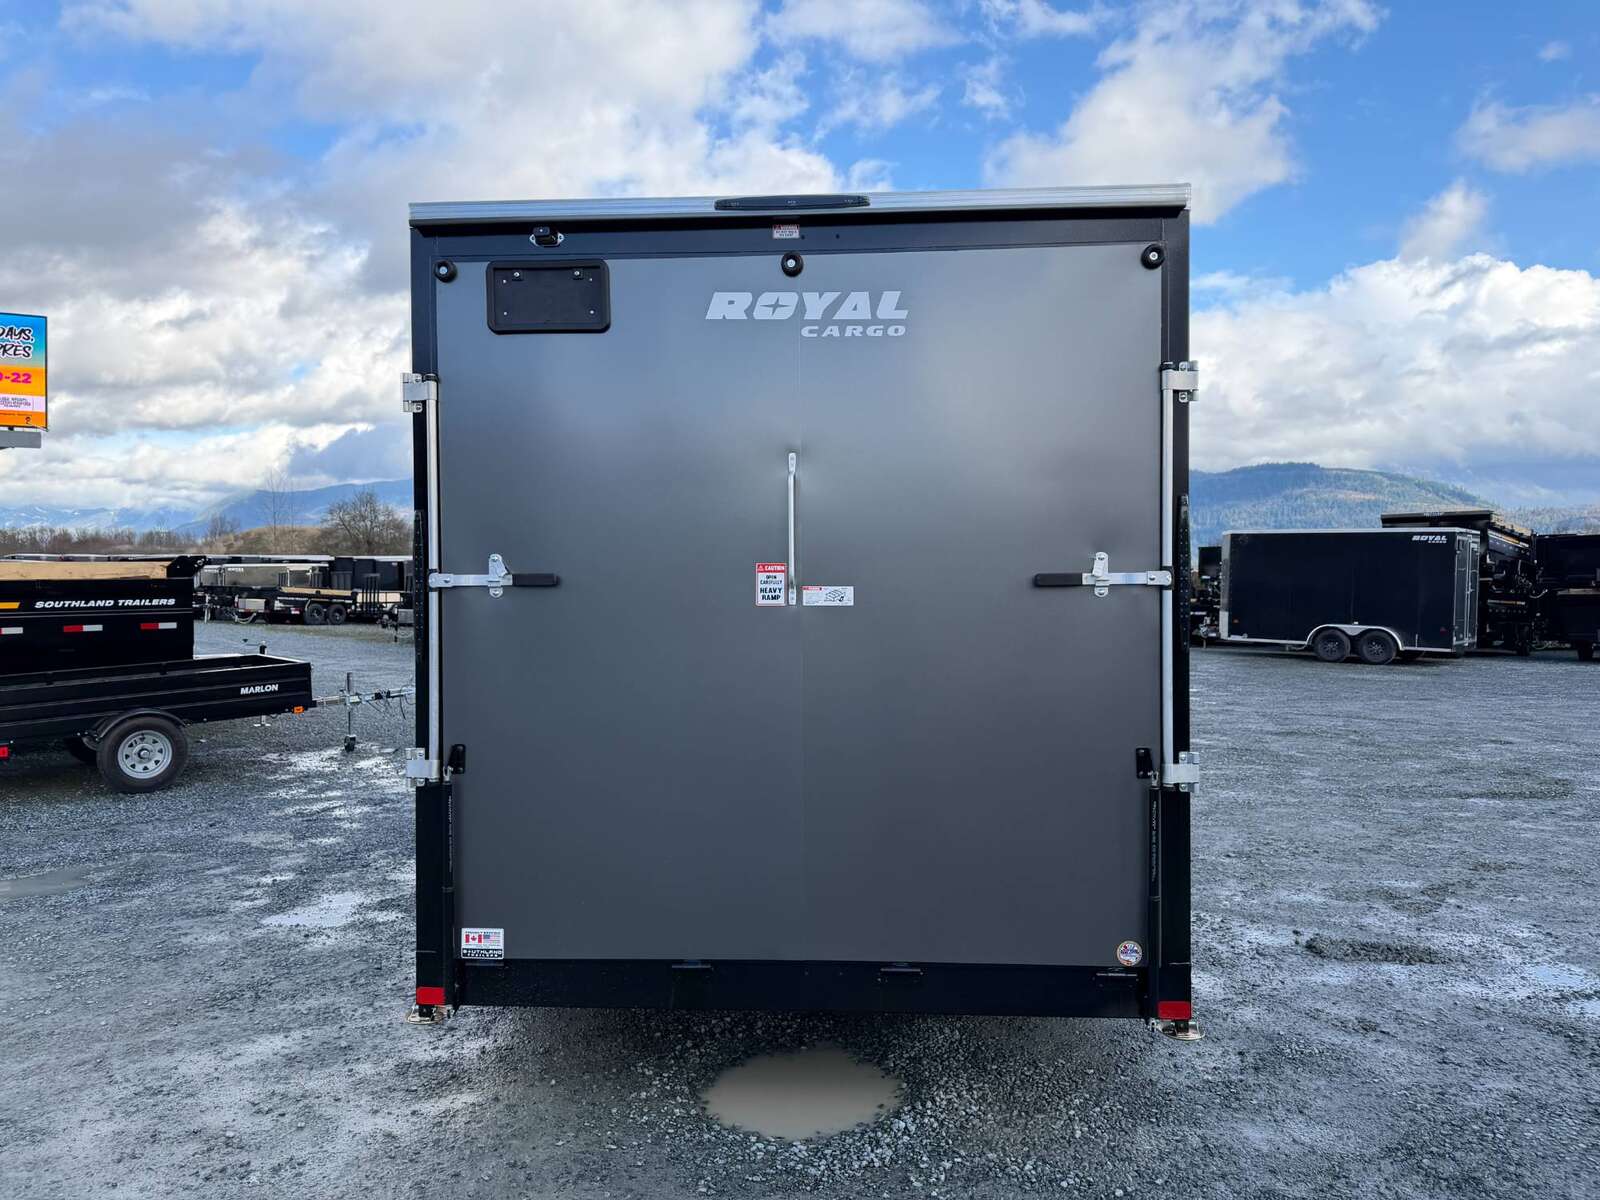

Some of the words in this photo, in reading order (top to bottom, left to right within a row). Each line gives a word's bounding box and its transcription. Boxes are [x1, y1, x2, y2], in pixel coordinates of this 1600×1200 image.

[705, 291, 908, 320] ROYAL
[800, 325, 906, 338] CARGO
[0, 372, 31, 383] -22
[34, 600, 115, 608] SOUTHLAND
[118, 598, 176, 606] TRAILERS
[240, 684, 279, 695] MARLON
